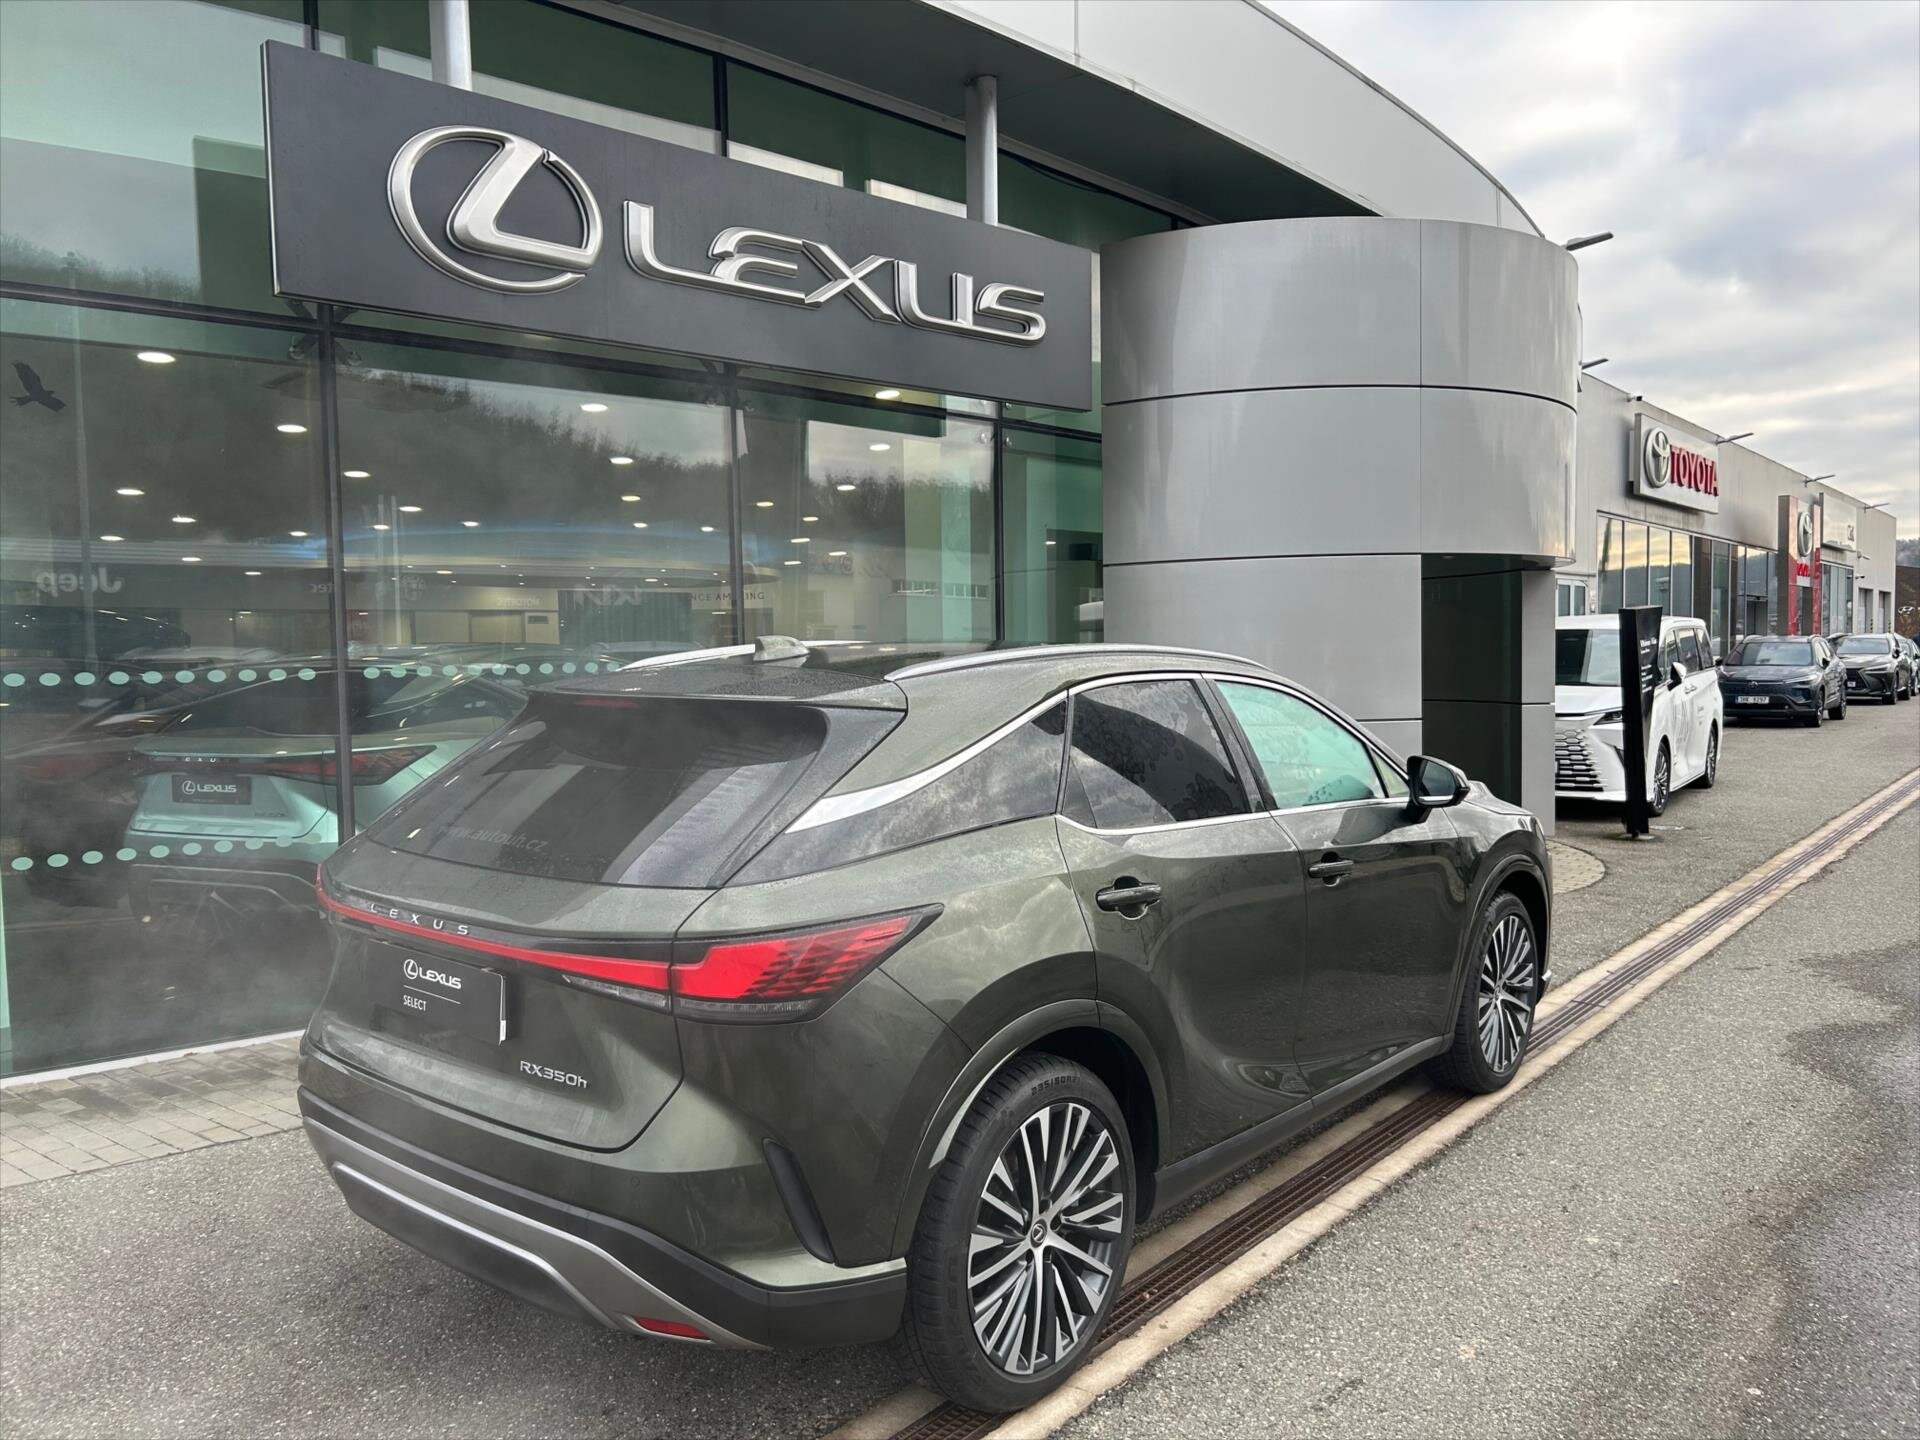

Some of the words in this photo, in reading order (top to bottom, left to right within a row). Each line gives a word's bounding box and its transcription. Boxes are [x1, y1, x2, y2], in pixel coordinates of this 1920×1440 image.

[623, 200, 1046, 348] LEXUS
[1671, 445, 1719, 498] TOYOTA
[715, 591, 765, 601] AMING
[196, 784, 237, 793] LEXUS
[370, 903, 469, 936] LEXUS
[419, 966, 462, 990] LEXUS
[403, 994, 428, 1012] SELECT
[520, 1060, 588, 1089] RX350h
